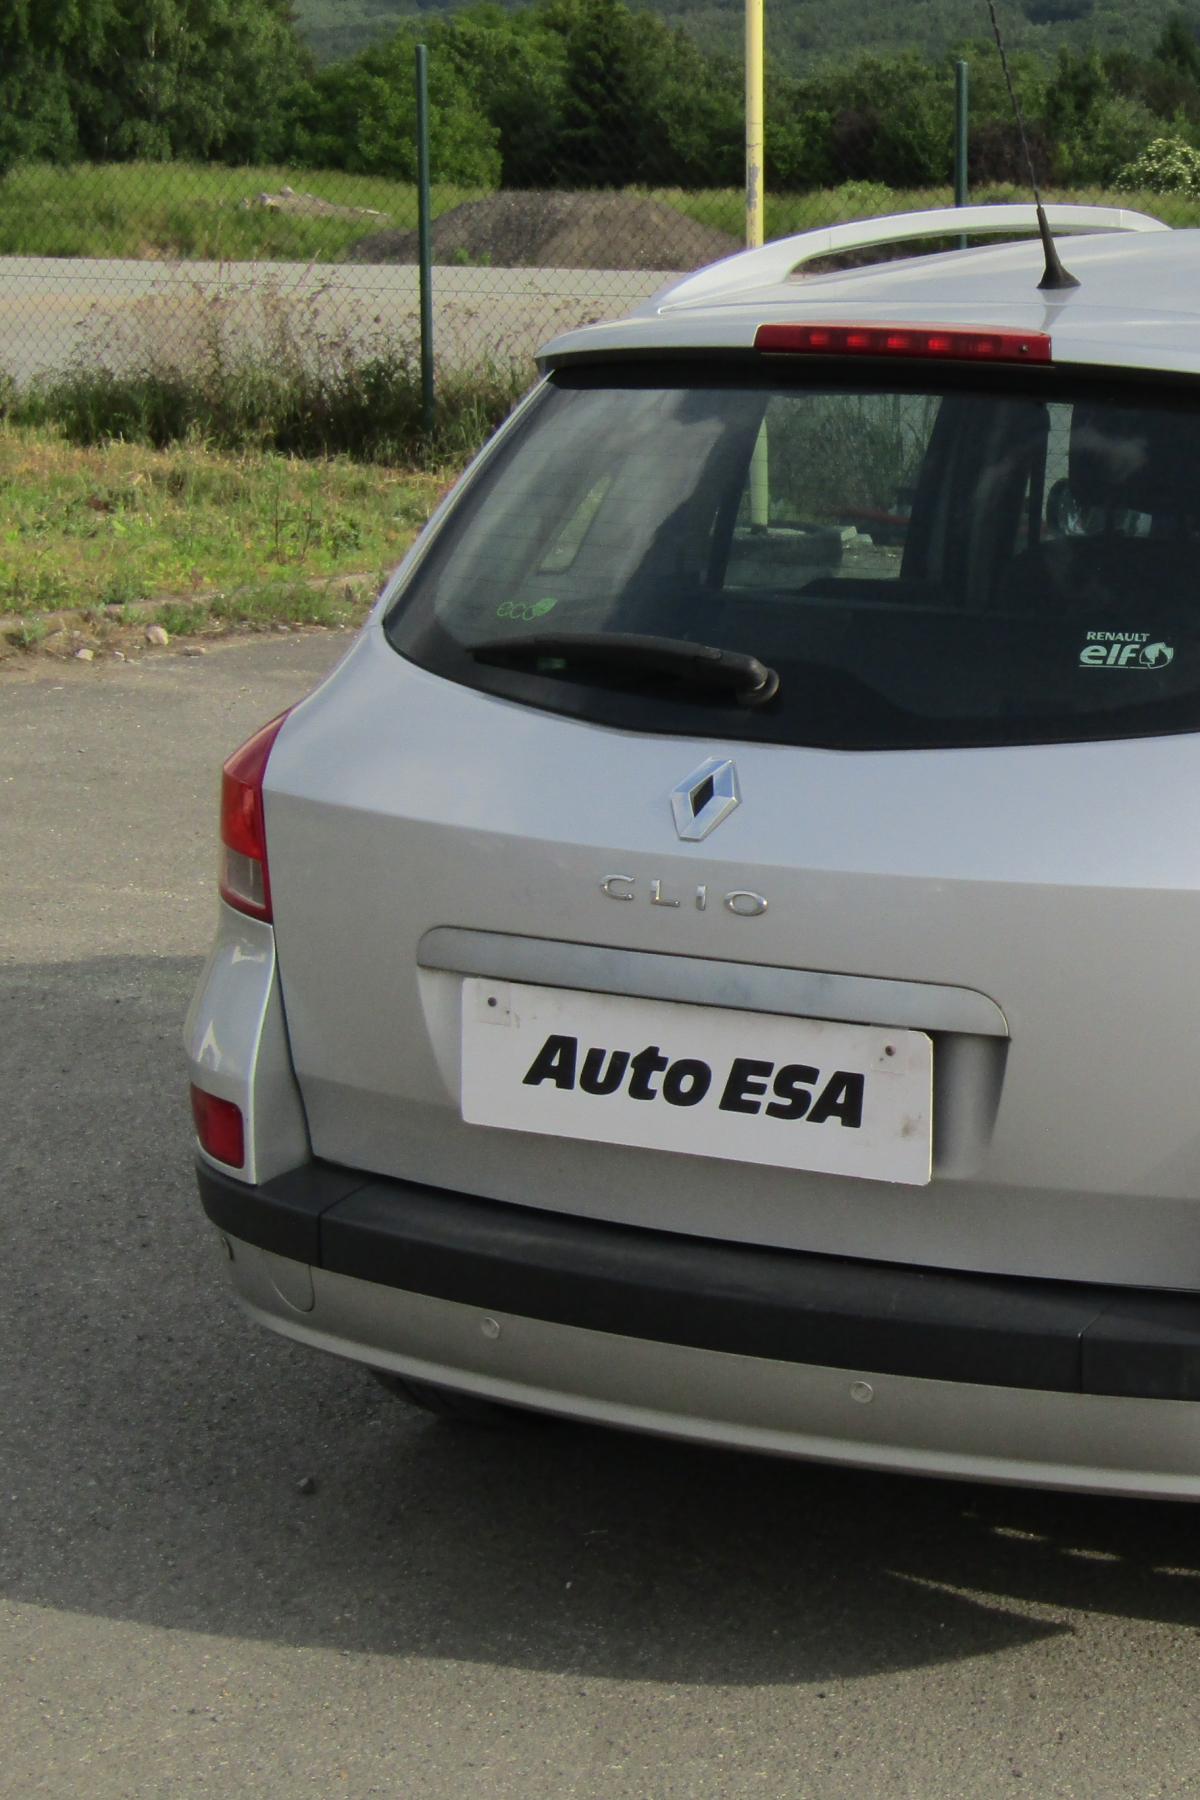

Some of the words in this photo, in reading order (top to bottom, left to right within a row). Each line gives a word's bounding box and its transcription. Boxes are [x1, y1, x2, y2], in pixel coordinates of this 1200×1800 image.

[1086, 631, 1150, 642] RENAULT
[1080, 643, 1140, 665] elf
[600, 874, 769, 917] CLIO
[522, 1034, 712, 1107] Auto
[718, 1057, 865, 1128] ESA
